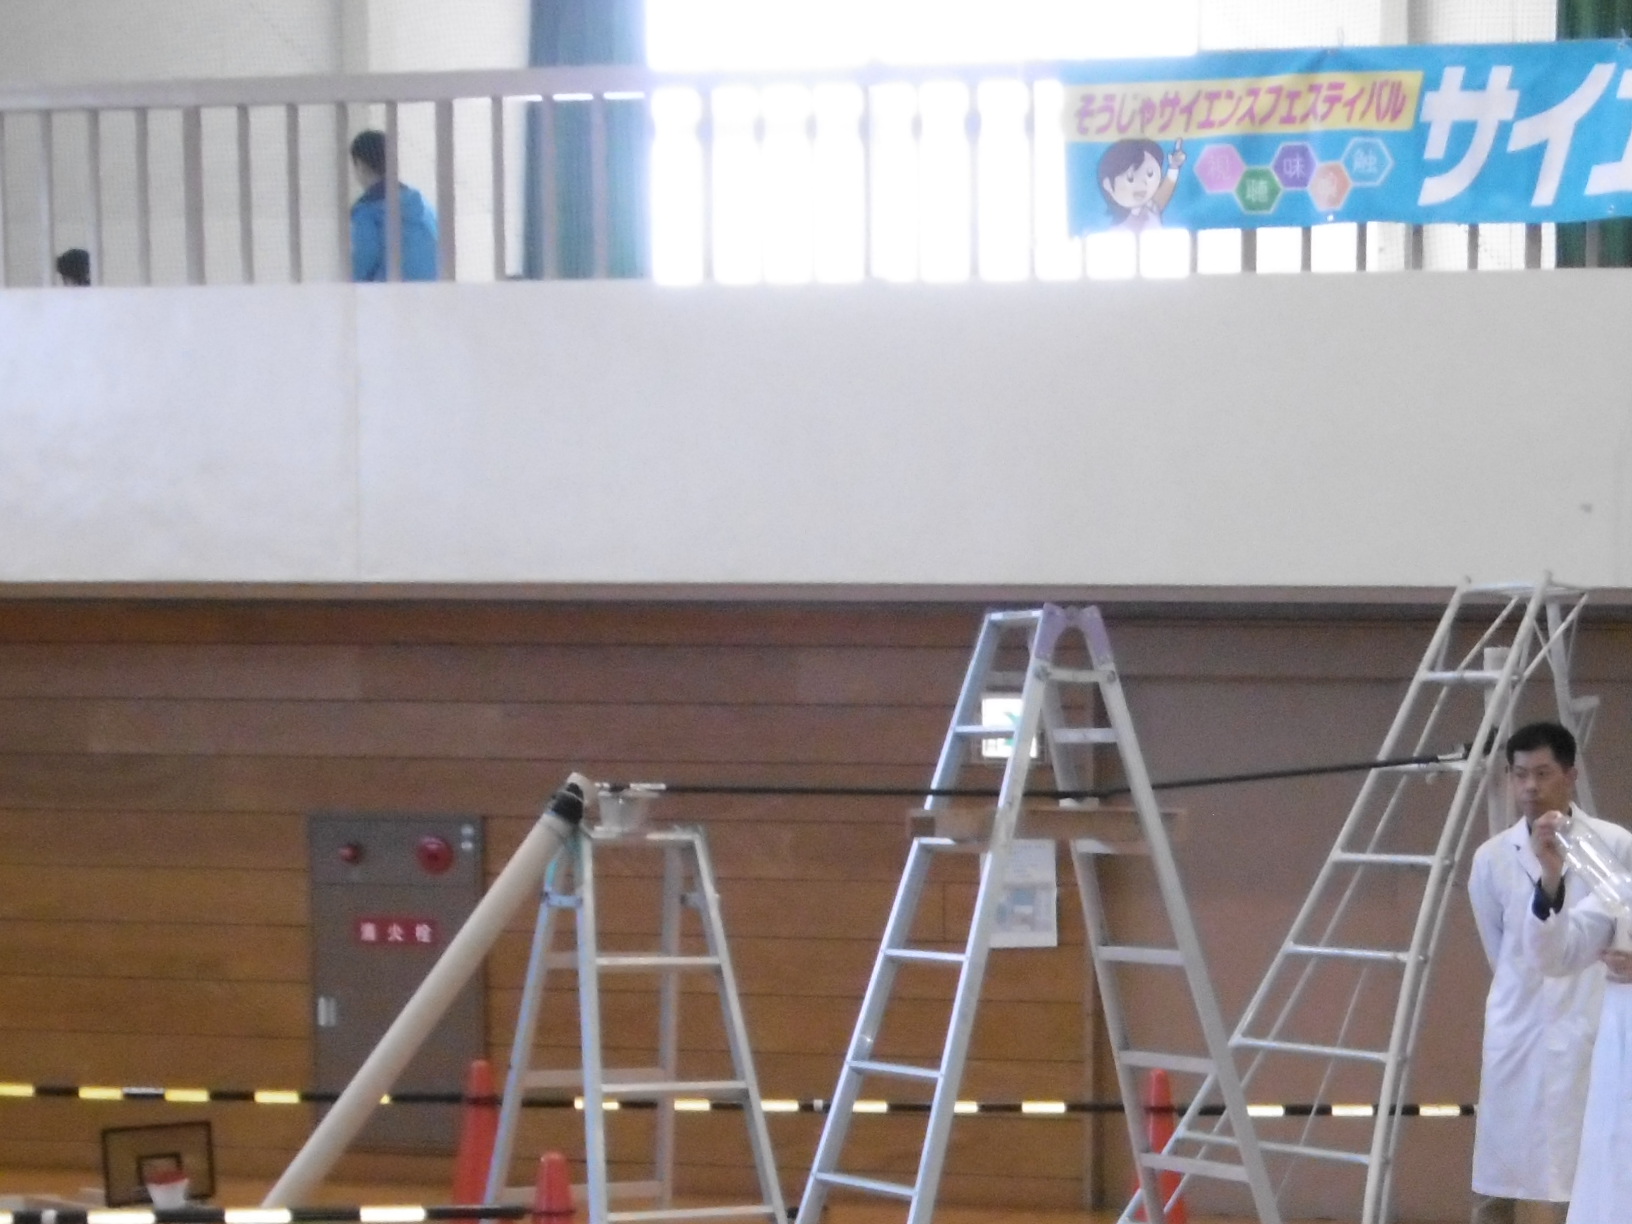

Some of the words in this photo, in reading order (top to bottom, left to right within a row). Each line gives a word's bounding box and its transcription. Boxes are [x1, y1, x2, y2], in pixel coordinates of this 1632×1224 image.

[1073, 79, 1407, 136] そうじゃサイエンスフェスティバル
